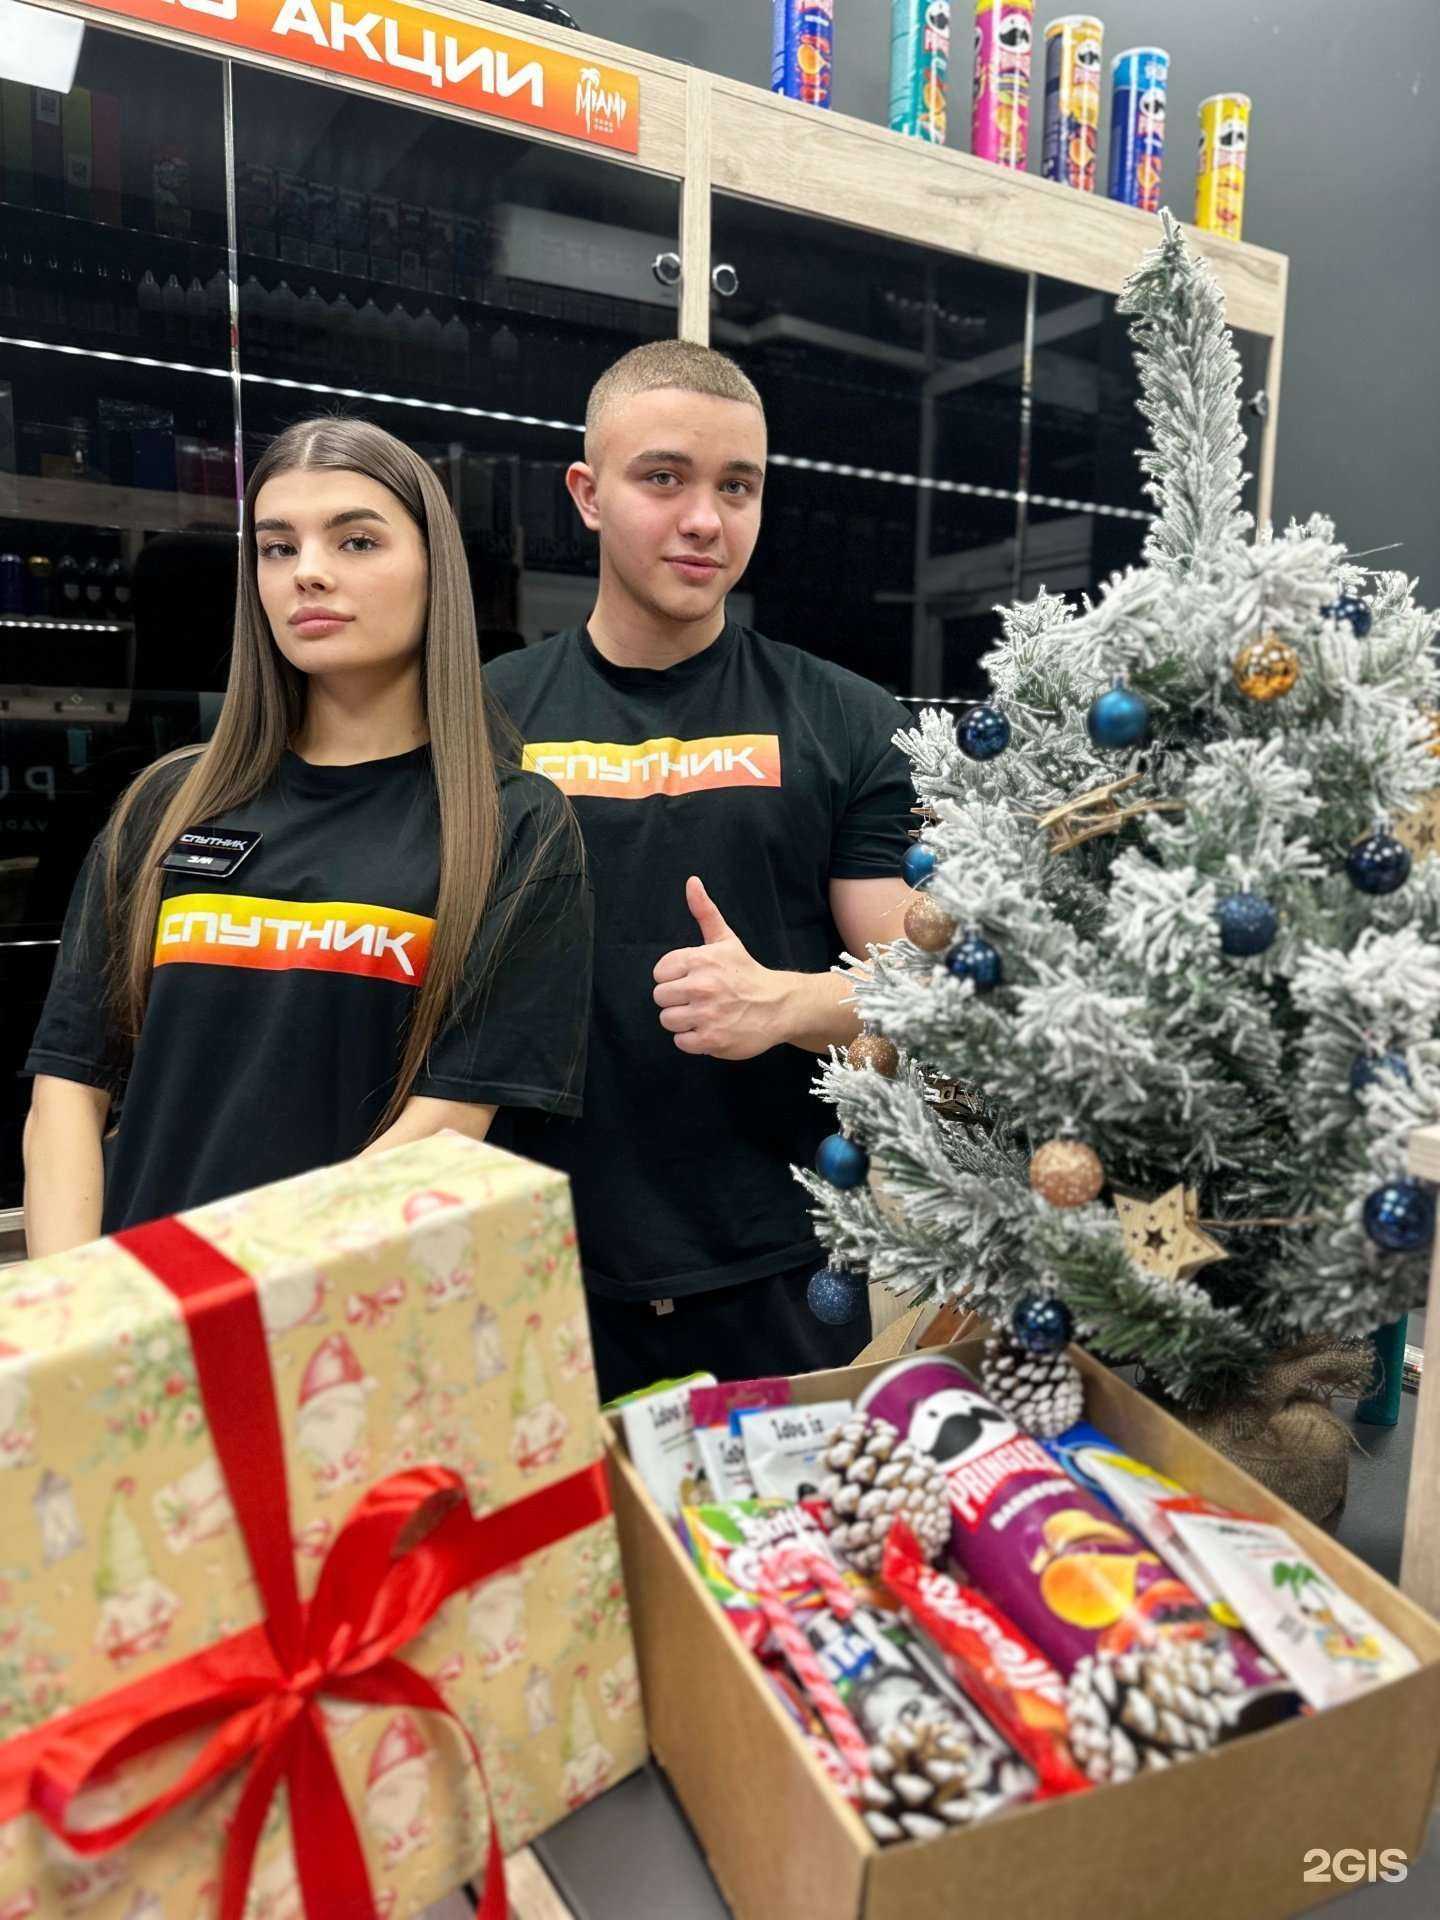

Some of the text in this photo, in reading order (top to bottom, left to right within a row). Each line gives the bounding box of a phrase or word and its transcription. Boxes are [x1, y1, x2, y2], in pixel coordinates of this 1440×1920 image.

[271, 0, 544, 107] АКЦИИ
[535, 747, 766, 783] СПУТНИК
[180, 834, 248, 851] СПУТНИК
[161, 911, 416, 977] СПУТНИК
